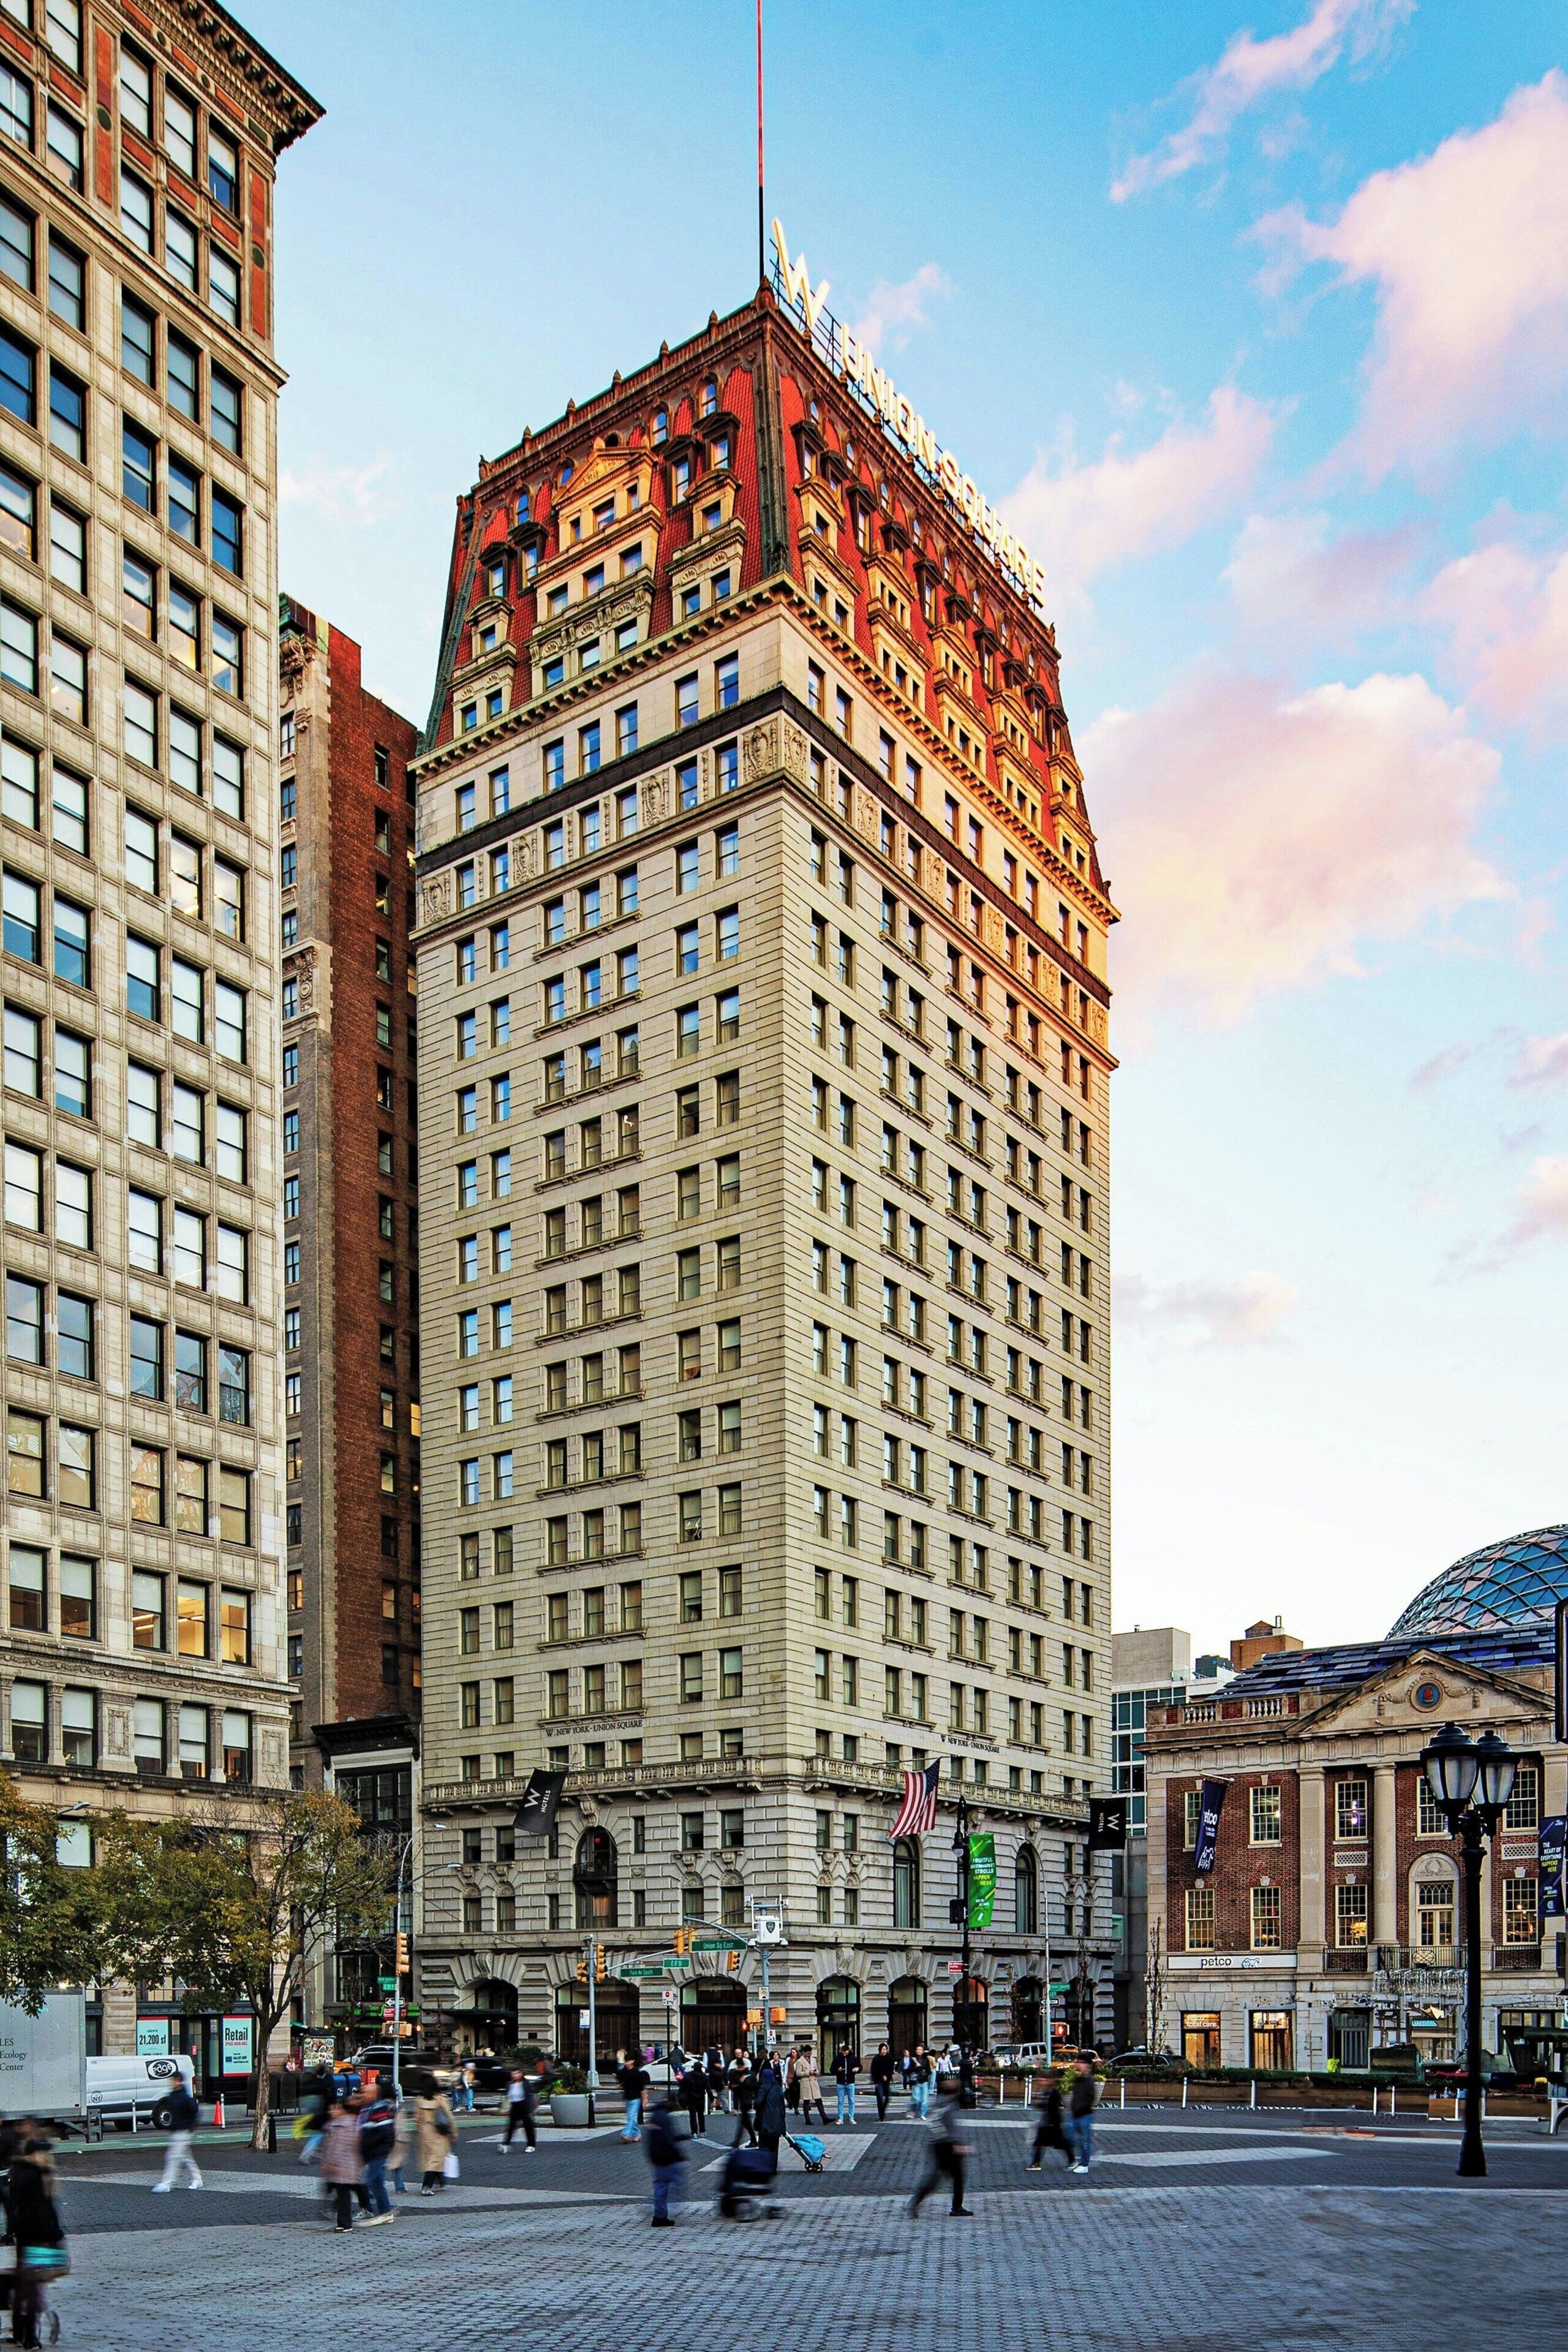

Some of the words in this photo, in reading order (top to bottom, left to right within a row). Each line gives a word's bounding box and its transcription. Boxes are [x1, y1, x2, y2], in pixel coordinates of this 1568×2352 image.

[772, 216, 831, 328] W
[840, 322, 935, 473] UNION
[940, 449, 1047, 606] SQUARE
[556, 1727, 571, 1736] NEW
[572, 1725, 589, 1734] YORK
[594, 1723, 616, 1732] UNION
[617, 1720, 643, 1728] SQUARE
[971, 1741, 984, 1750] UNION
[985, 1744, 1000, 1753] SQUARE
[524, 1788, 541, 1807] W
[540, 1790, 551, 1813] HOTELS
[1107, 1813, 1120, 1831] W
[1200, 1956, 1232, 1969] petco
[139, 2034, 159, 2045] 21,200
[160, 2034, 166, 2044] sf
[225, 2027, 248, 2041] Retail
[0, 2038, 14, 2046] LES
[0, 2050, 28, 2060] Ecology
[0, 2062, 24, 2071] Center
